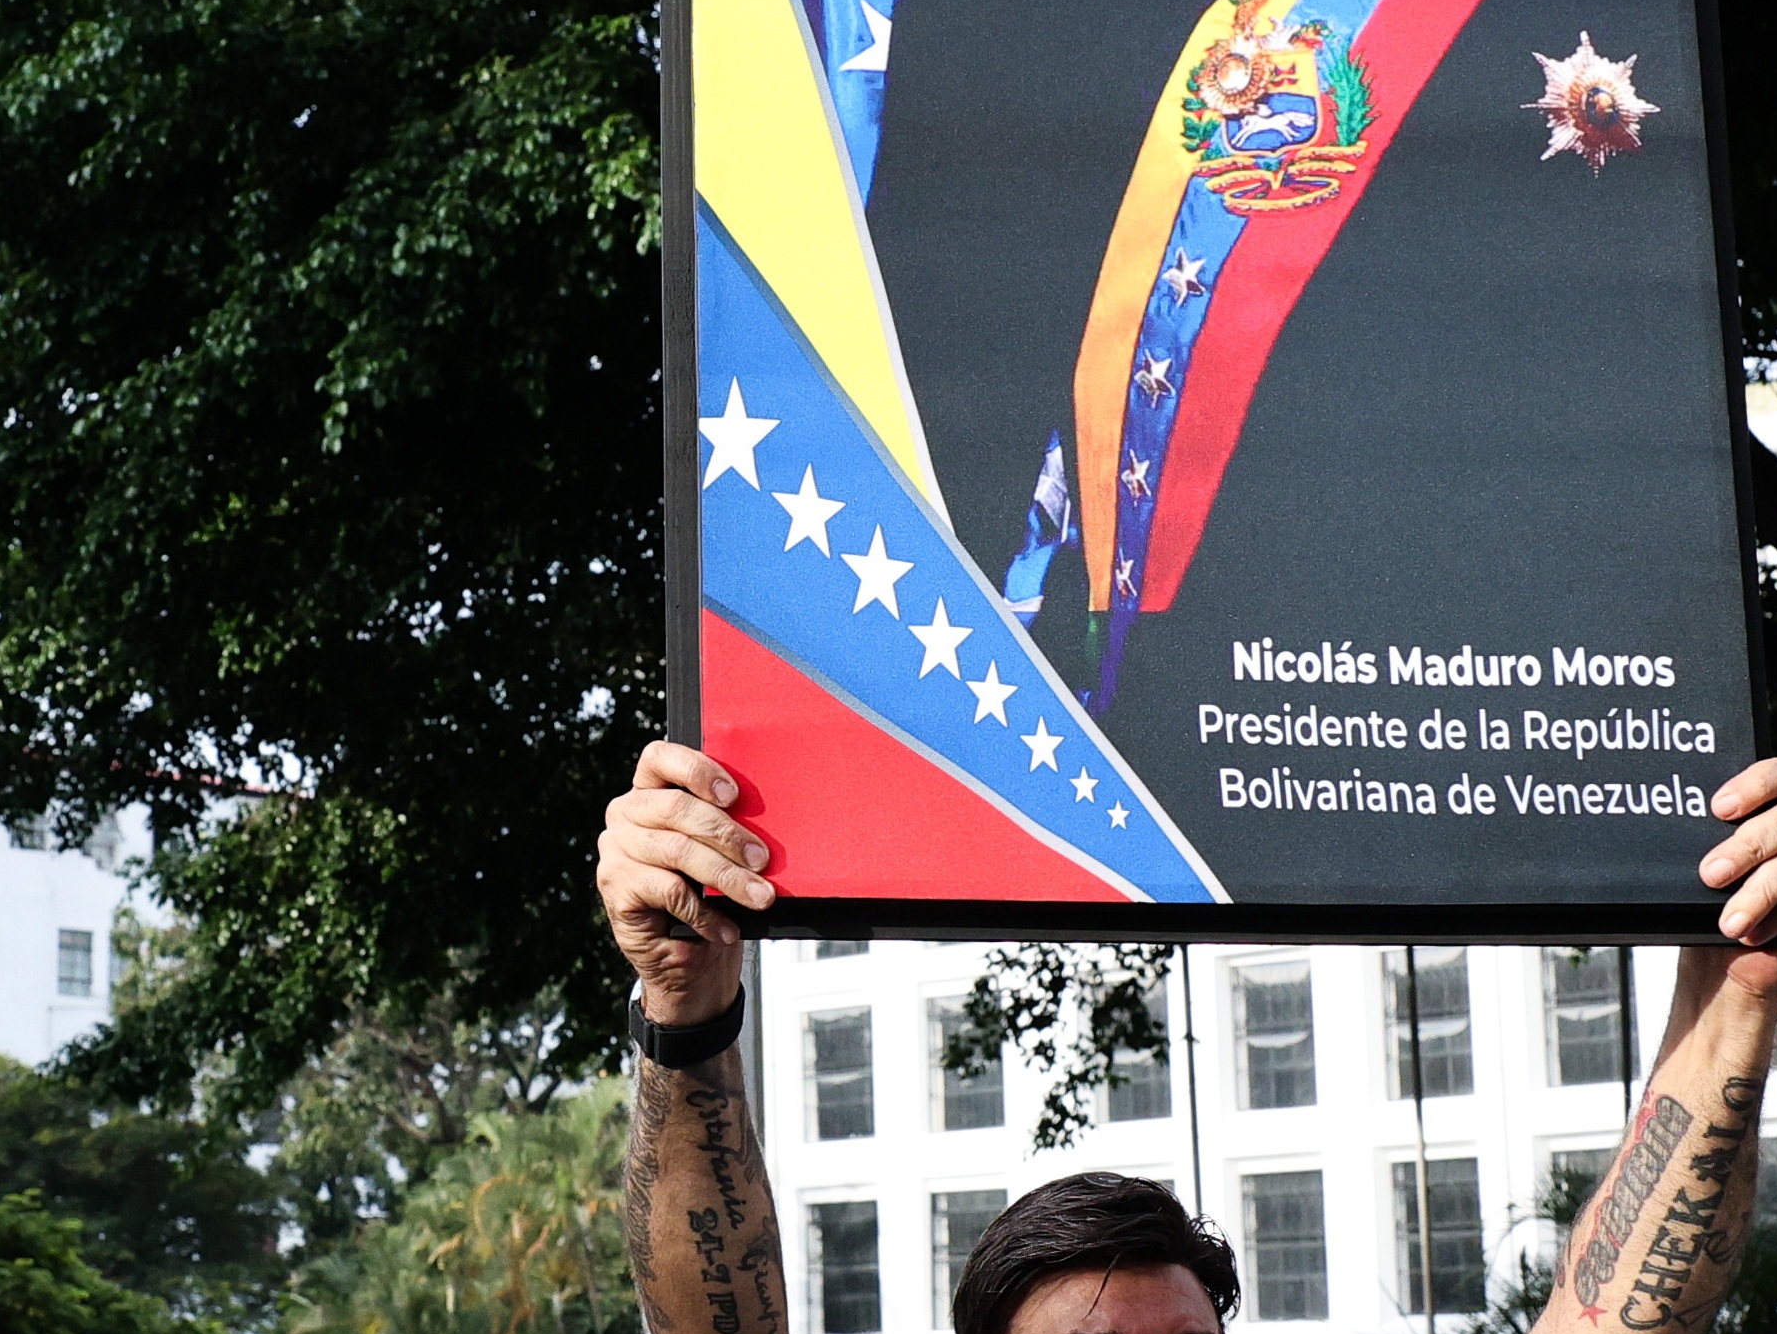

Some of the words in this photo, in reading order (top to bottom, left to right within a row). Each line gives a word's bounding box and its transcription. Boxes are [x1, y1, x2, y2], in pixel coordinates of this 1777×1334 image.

[1232, 636, 1379, 685] Nicolás
[1388, 644, 1542, 687] Maduro
[1552, 646, 1676, 688] Moros
[1198, 702, 1408, 750] Presidente
[1418, 708, 1468, 751] de
[1478, 708, 1511, 751] la
[1523, 707, 1716, 761] República
[1219, 766, 1437, 815] Bolivariana
[1447, 772, 1497, 815] de
[1503, 773, 1707, 818] Venezuela
